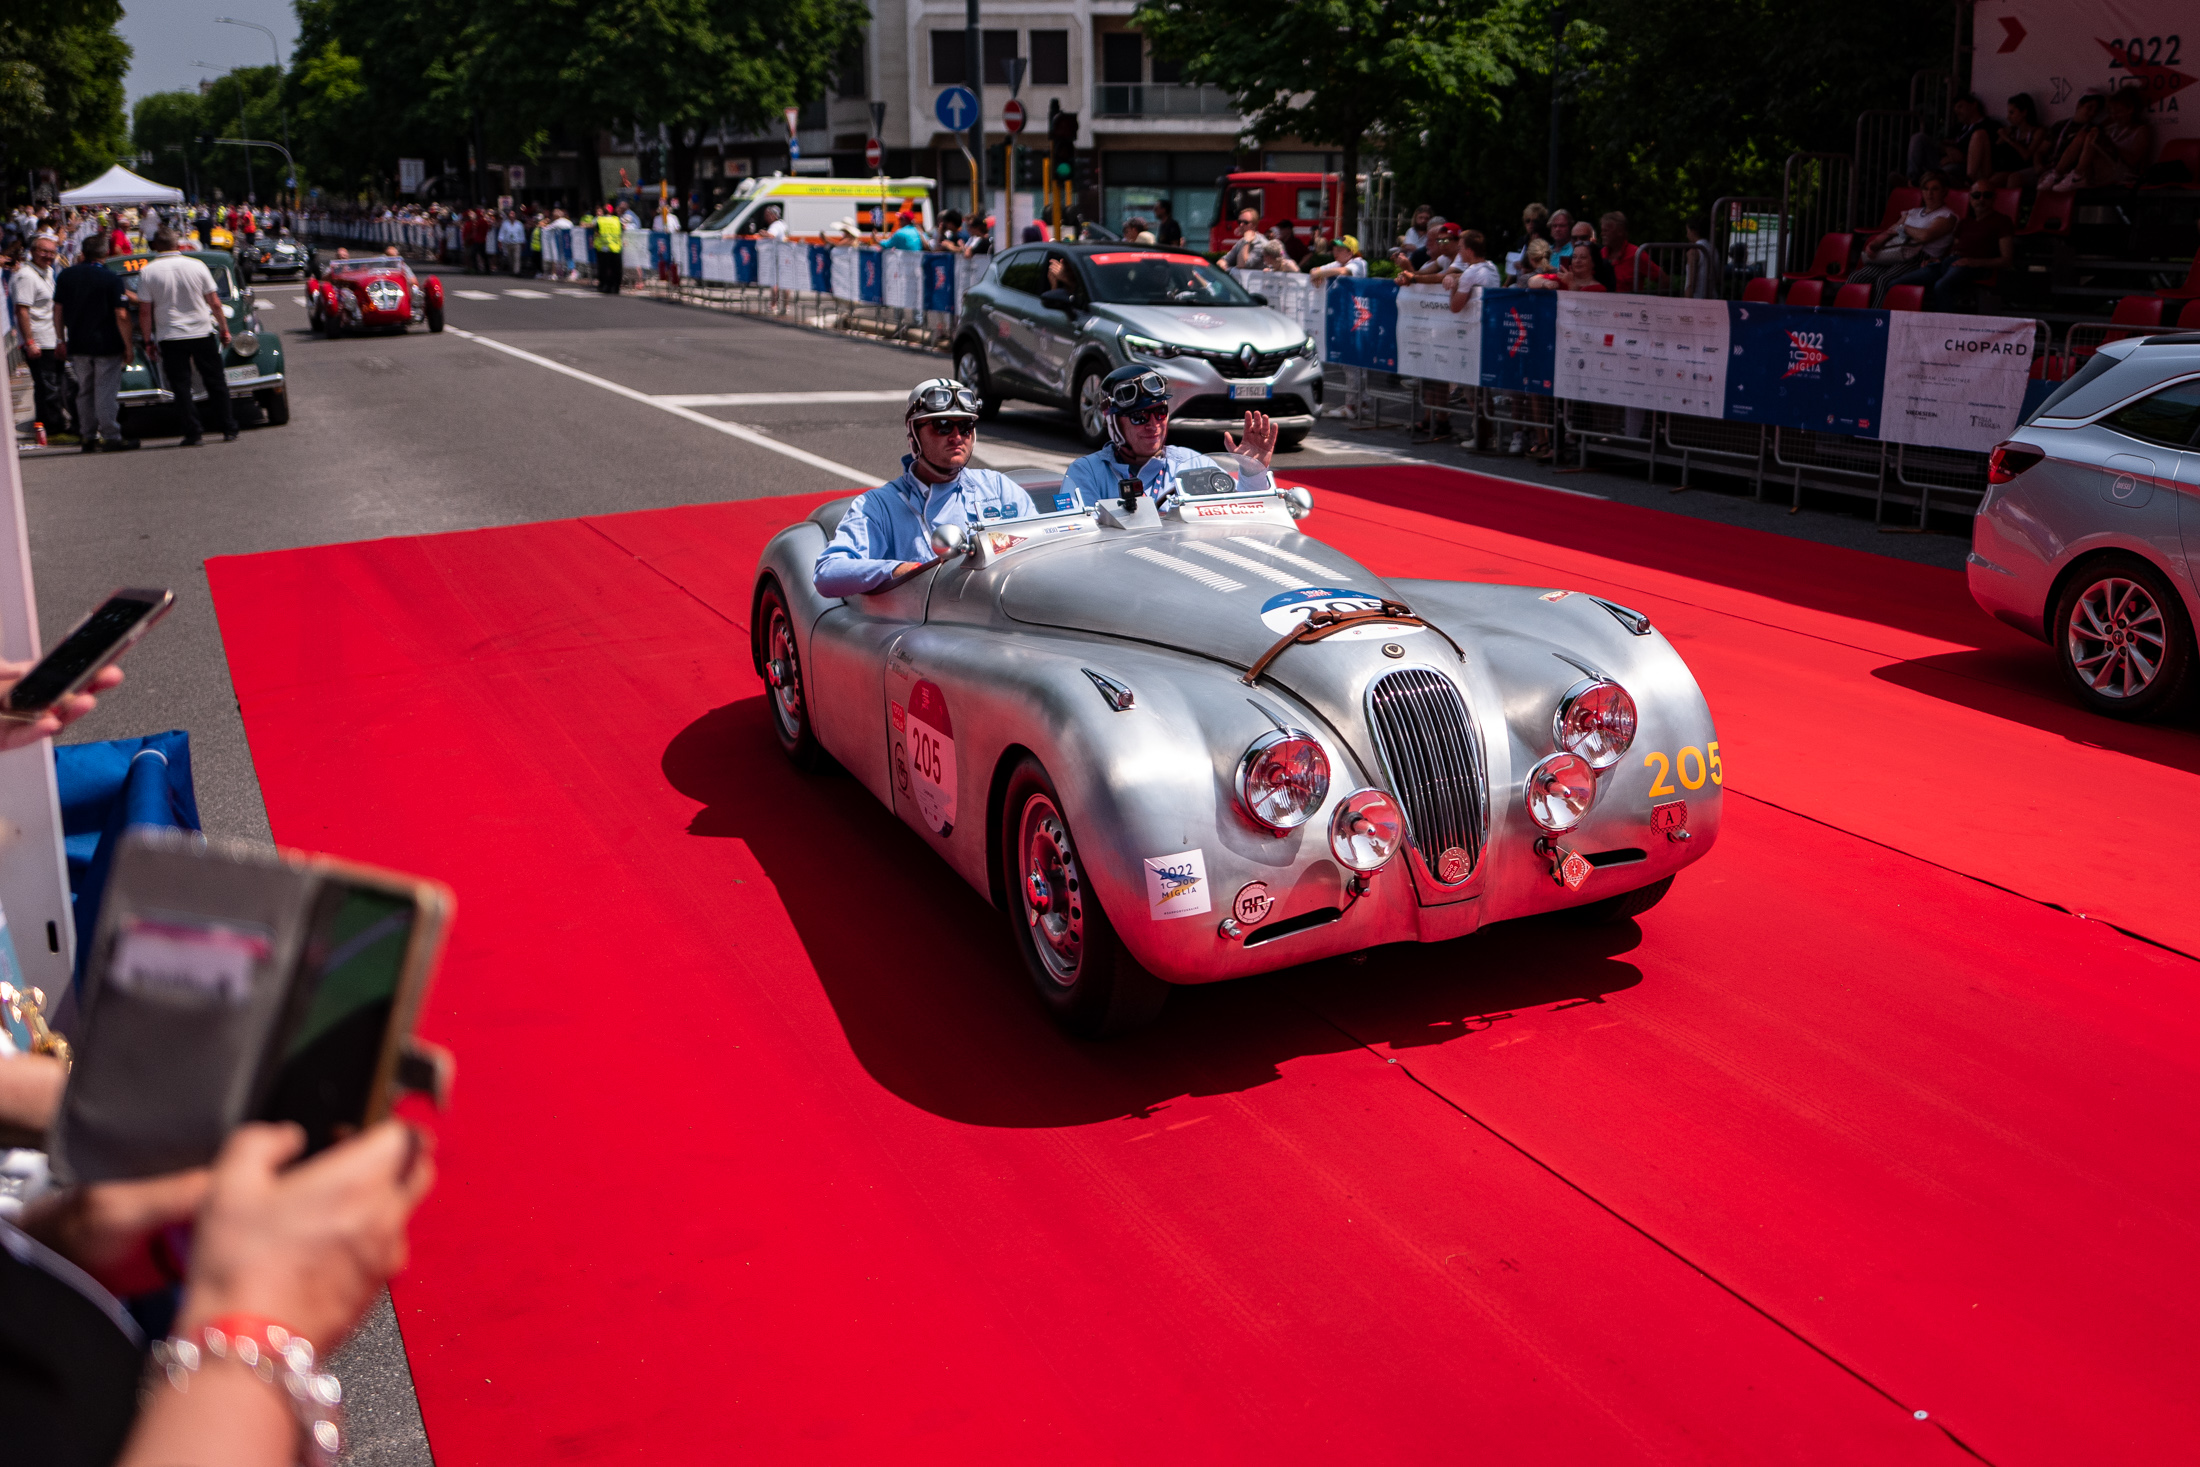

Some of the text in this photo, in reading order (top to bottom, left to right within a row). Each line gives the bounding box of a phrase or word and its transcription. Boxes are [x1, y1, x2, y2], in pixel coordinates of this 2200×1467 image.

[2109, 35, 2181, 69] 2022
[1420, 300, 1451, 311] CHOPAR
[1790, 331, 1824, 349] 2022
[1944, 339, 2027, 356] CHOPARD
[1787, 361, 1821, 373] MIGLIA
[913, 727, 942, 784] 205
[1643, 741, 1723, 798] 205
[1665, 811, 1674, 826] A
[1159, 863, 1194, 880] 2022
[1161, 886, 1197, 899] MIGLIA
